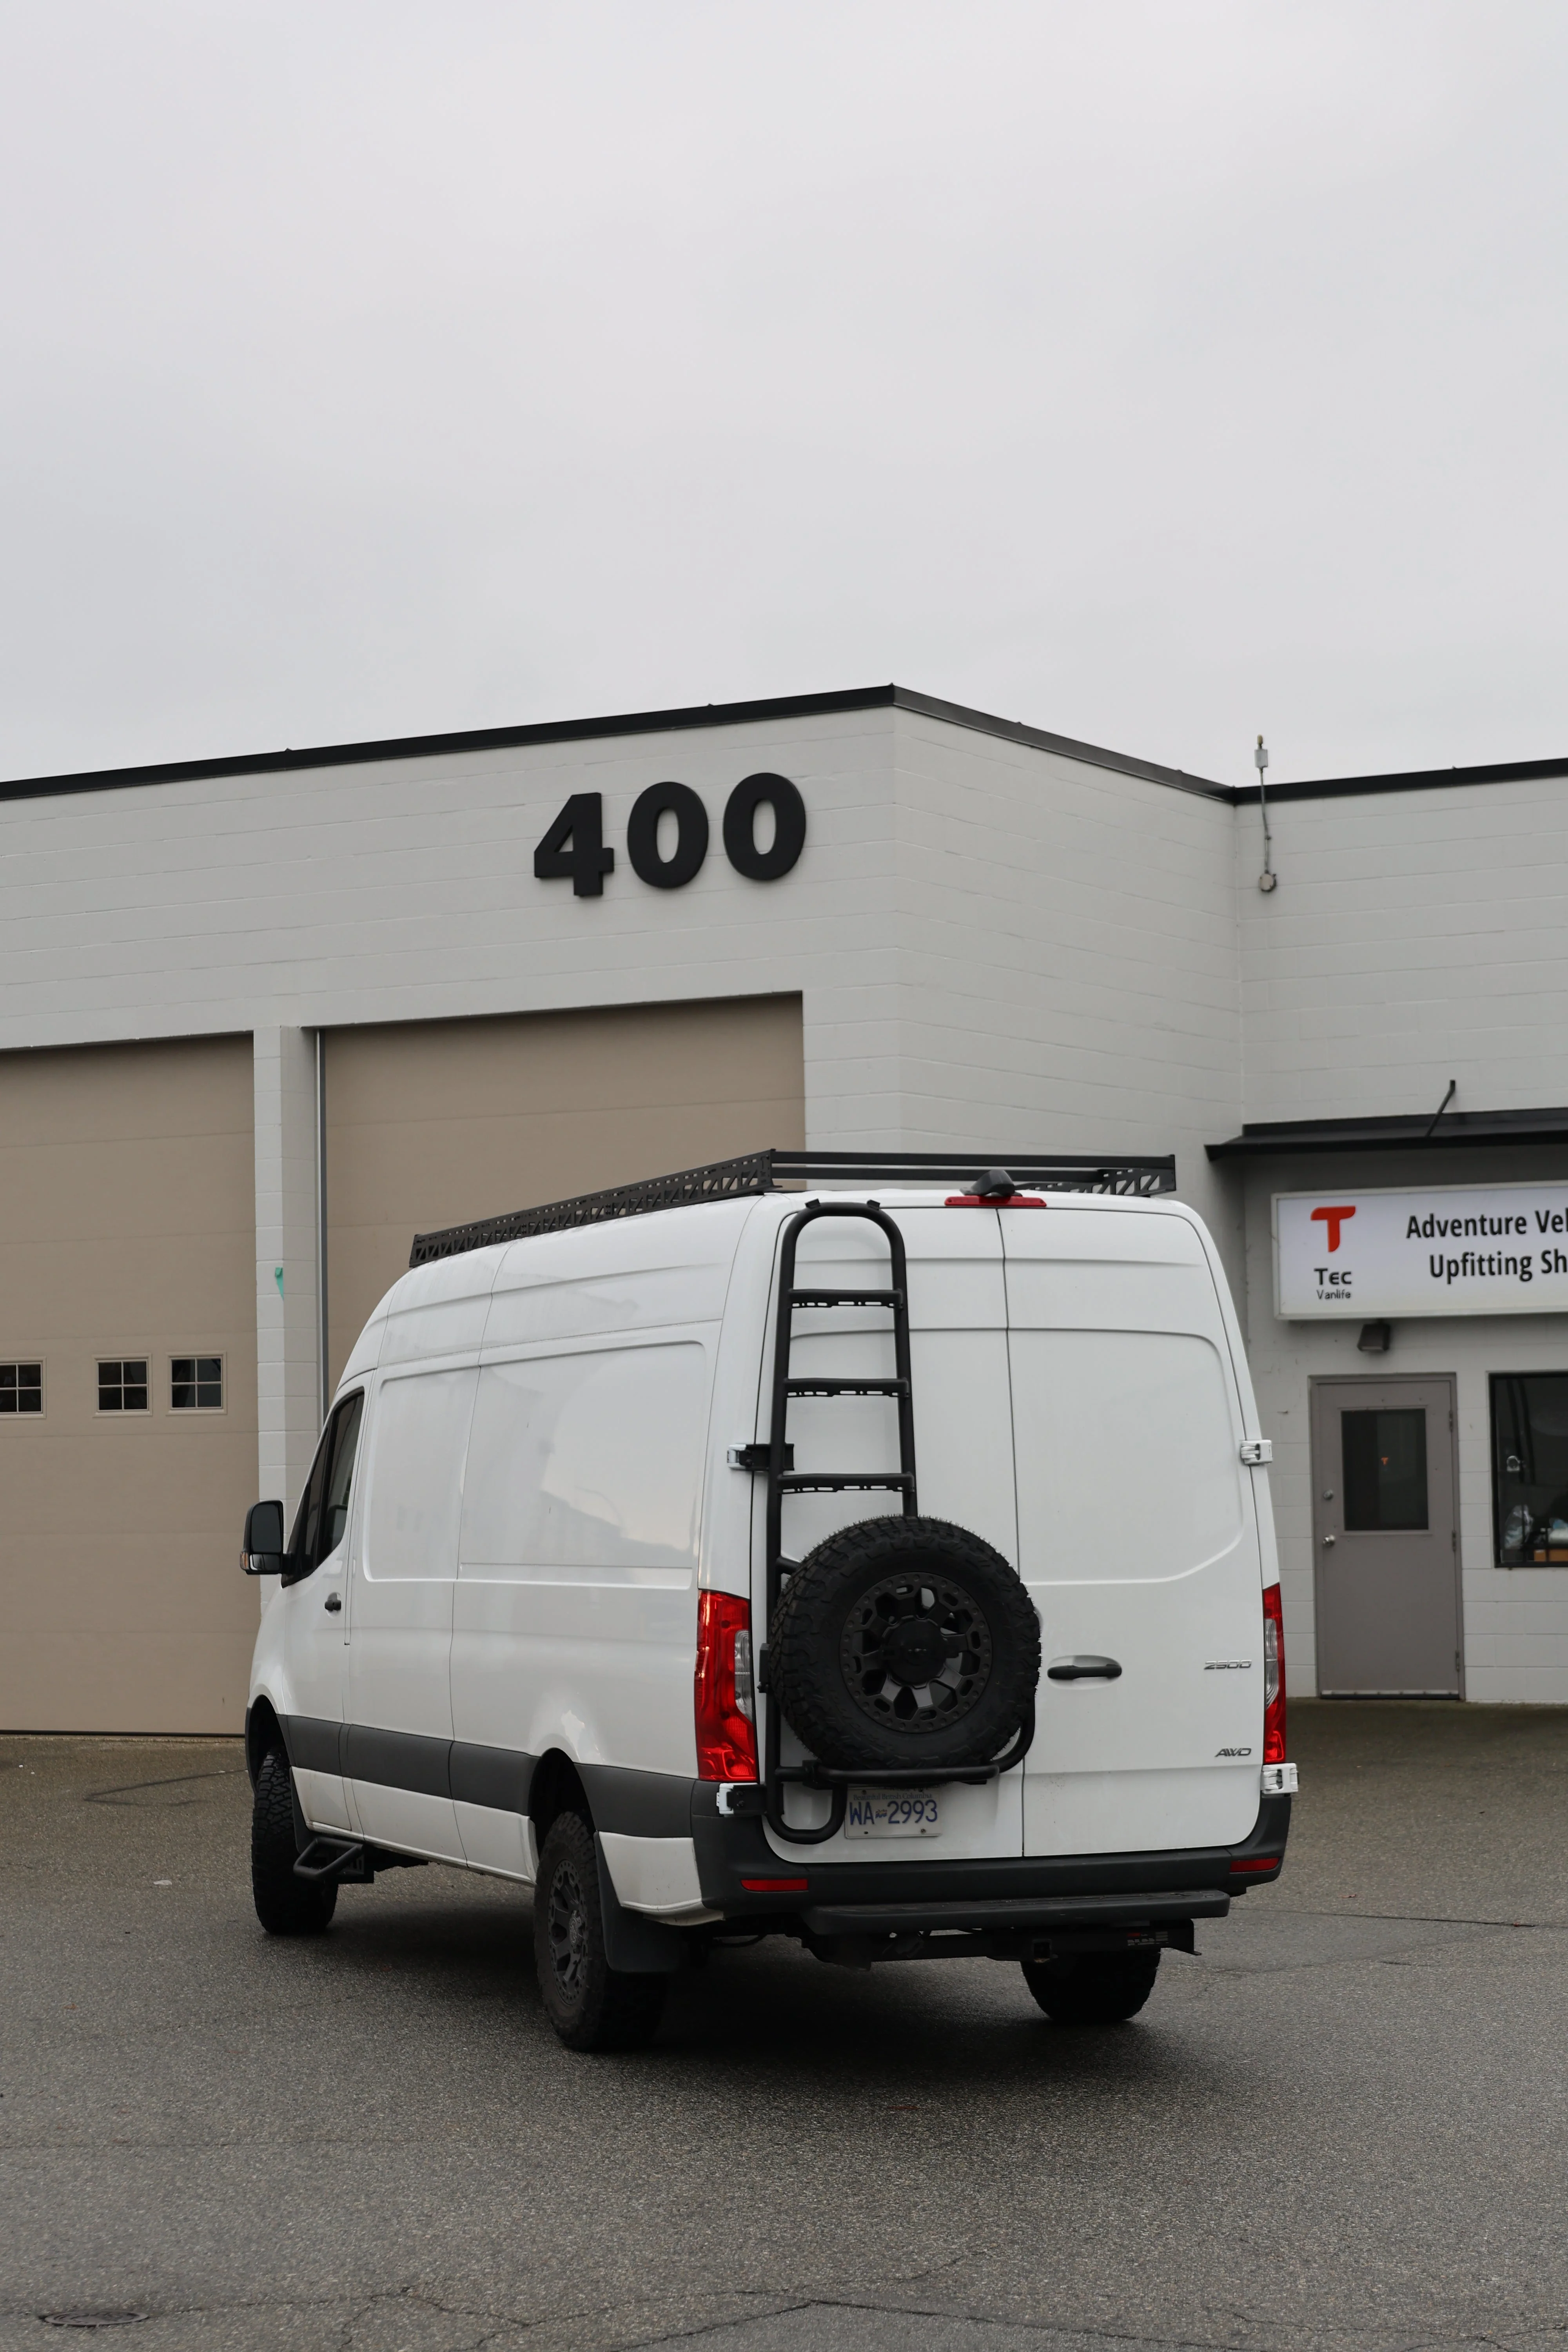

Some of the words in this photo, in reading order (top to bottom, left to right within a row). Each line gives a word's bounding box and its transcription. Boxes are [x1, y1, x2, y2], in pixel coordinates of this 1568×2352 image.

[534, 773, 806, 897] 400
[1406, 1213, 1527, 1238] Adventure
[1535, 1208, 1568, 1234] Ve
[1430, 1251, 1533, 1285] Upfitting
[1317, 1289, 1351, 1300] Vanlife
[1204, 1660, 1252, 1670] 2500
[1215, 1748, 1252, 1757] AWD
